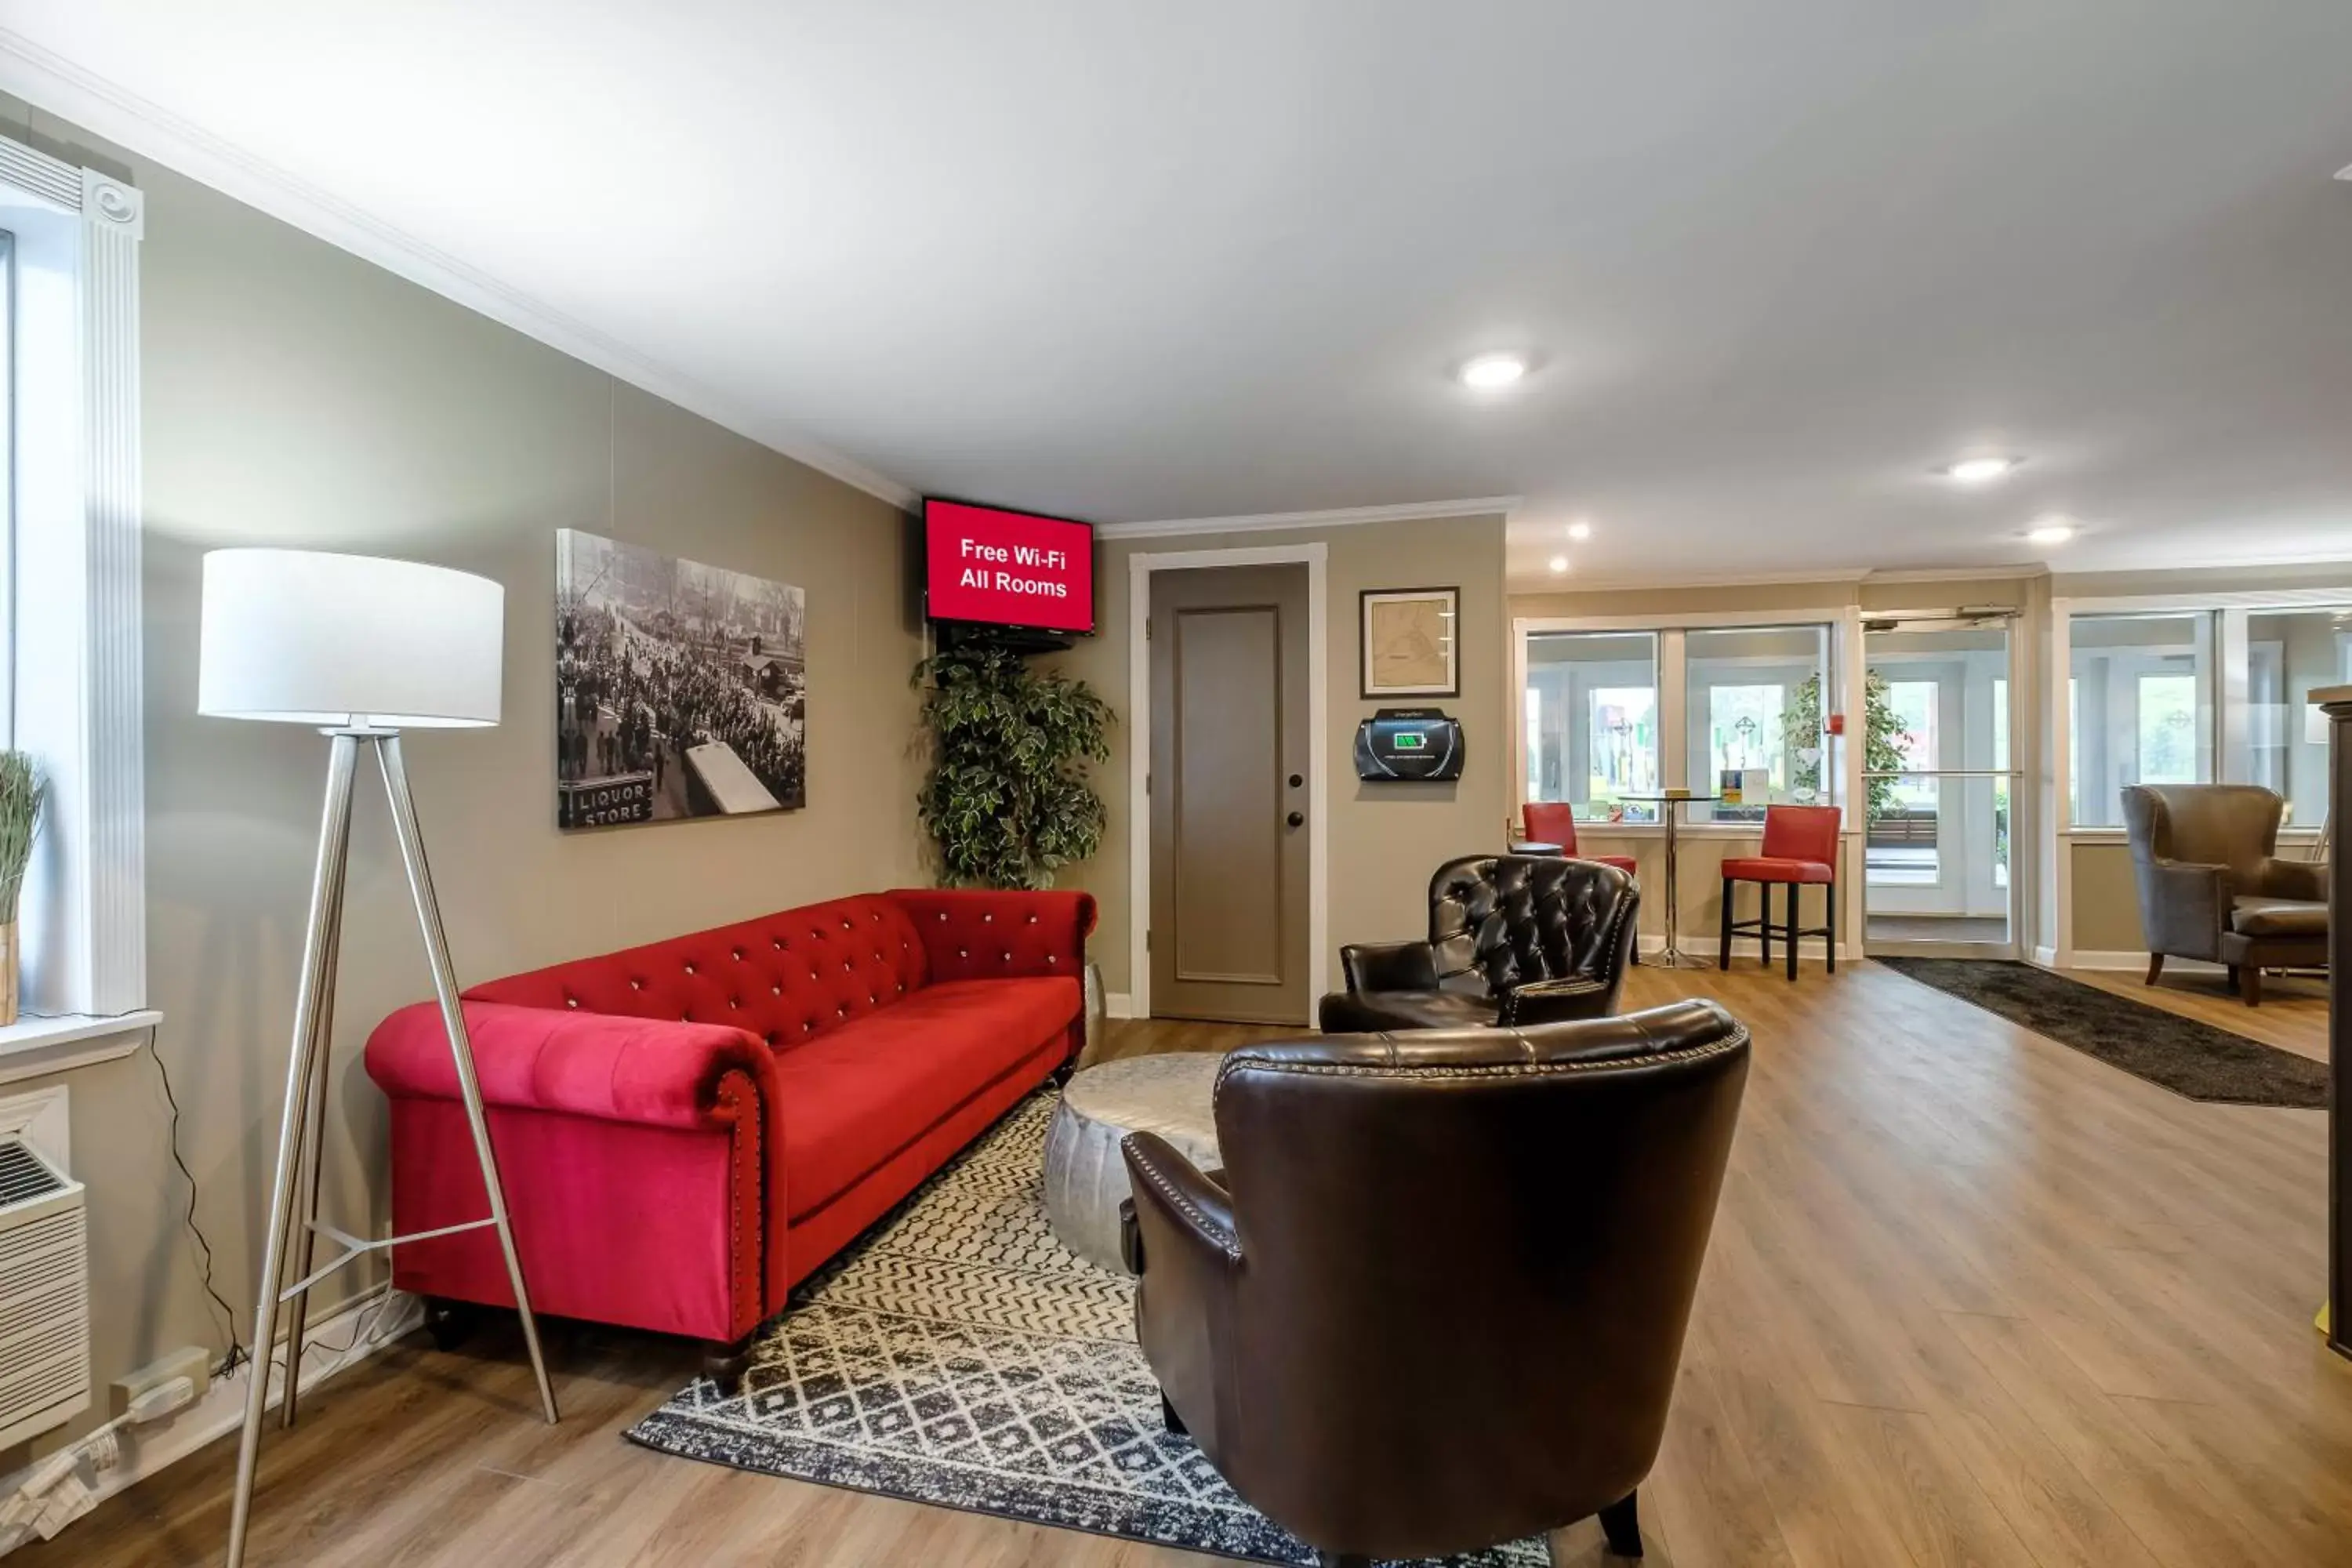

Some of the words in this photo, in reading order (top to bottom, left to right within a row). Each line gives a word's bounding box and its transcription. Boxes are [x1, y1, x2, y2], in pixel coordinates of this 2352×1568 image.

[960, 539, 1008, 563] Free
[1014, 546, 1065, 570] Wi-Fi
[960, 568, 989, 589] All
[996, 572, 1067, 598] Rooms
[580, 785, 644, 809] LIQUOR
[585, 804, 641, 827] STORE
